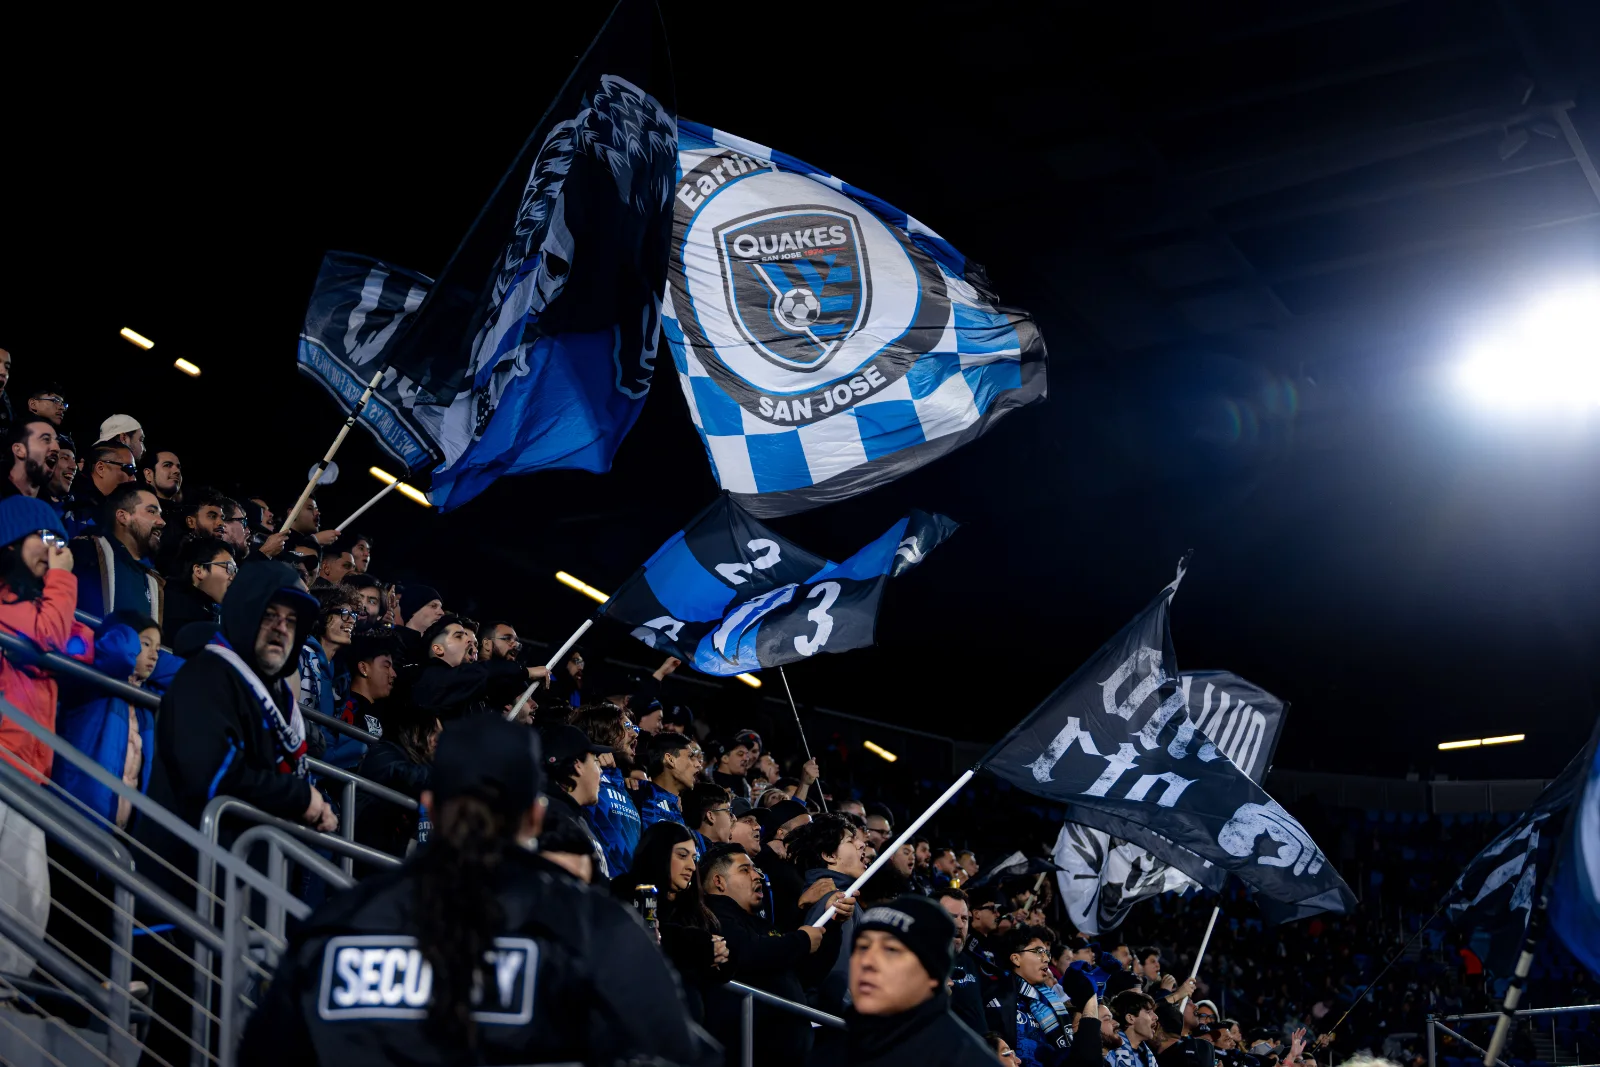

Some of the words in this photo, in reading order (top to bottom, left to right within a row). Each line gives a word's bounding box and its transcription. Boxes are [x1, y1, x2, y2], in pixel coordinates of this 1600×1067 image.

[733, 225, 847, 258] QUAKES
[781, 251, 802, 260] JOSE
[758, 396, 812, 422] SAN
[818, 364, 887, 414] JOSE
[793, 581, 842, 657] 3
[333, 947, 525, 1009] SECUY
